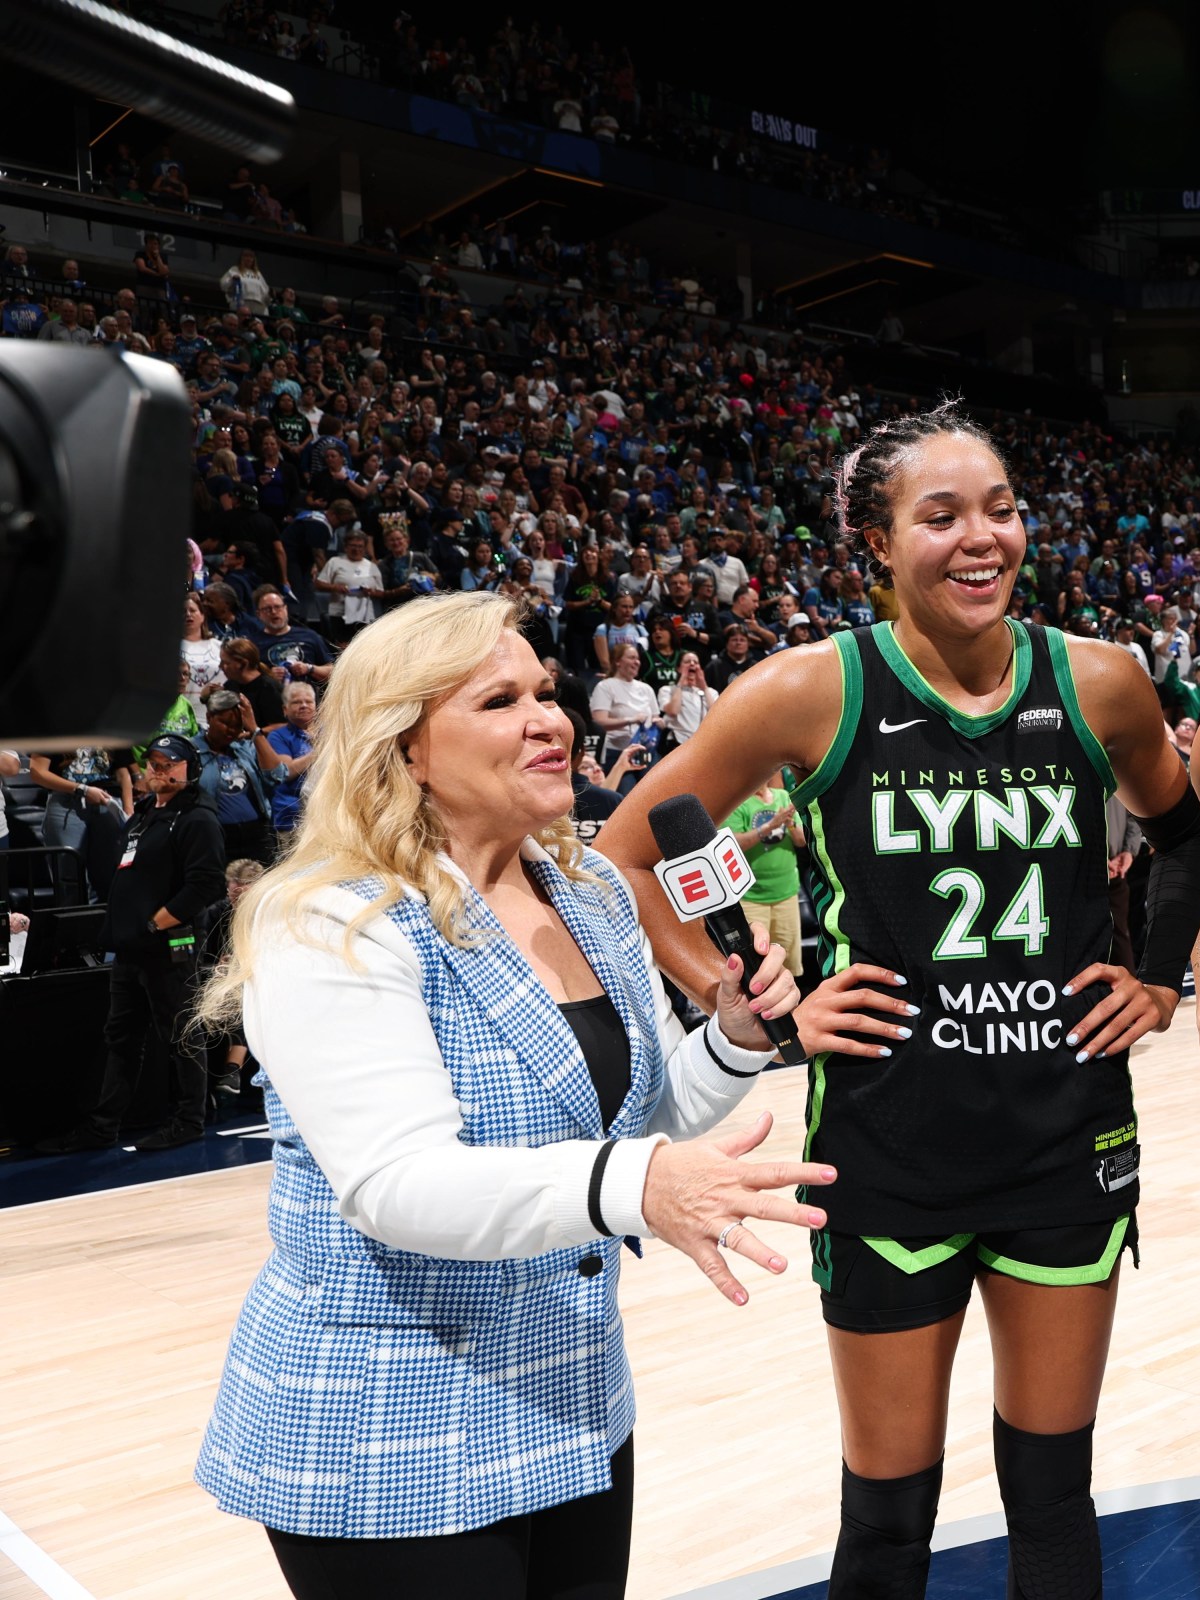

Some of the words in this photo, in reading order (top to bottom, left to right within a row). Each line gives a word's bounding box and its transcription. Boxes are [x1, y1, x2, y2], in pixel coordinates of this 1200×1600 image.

[794, 122, 818, 150] OUT
[136, 229, 176, 252] 12
[873, 764, 1075, 786] MINNESOTA
[871, 785, 1083, 856] LYNX
[929, 863, 1050, 961] 24
[937, 979, 1057, 1014] MAYO
[931, 1017, 1063, 1055] CLINIC
